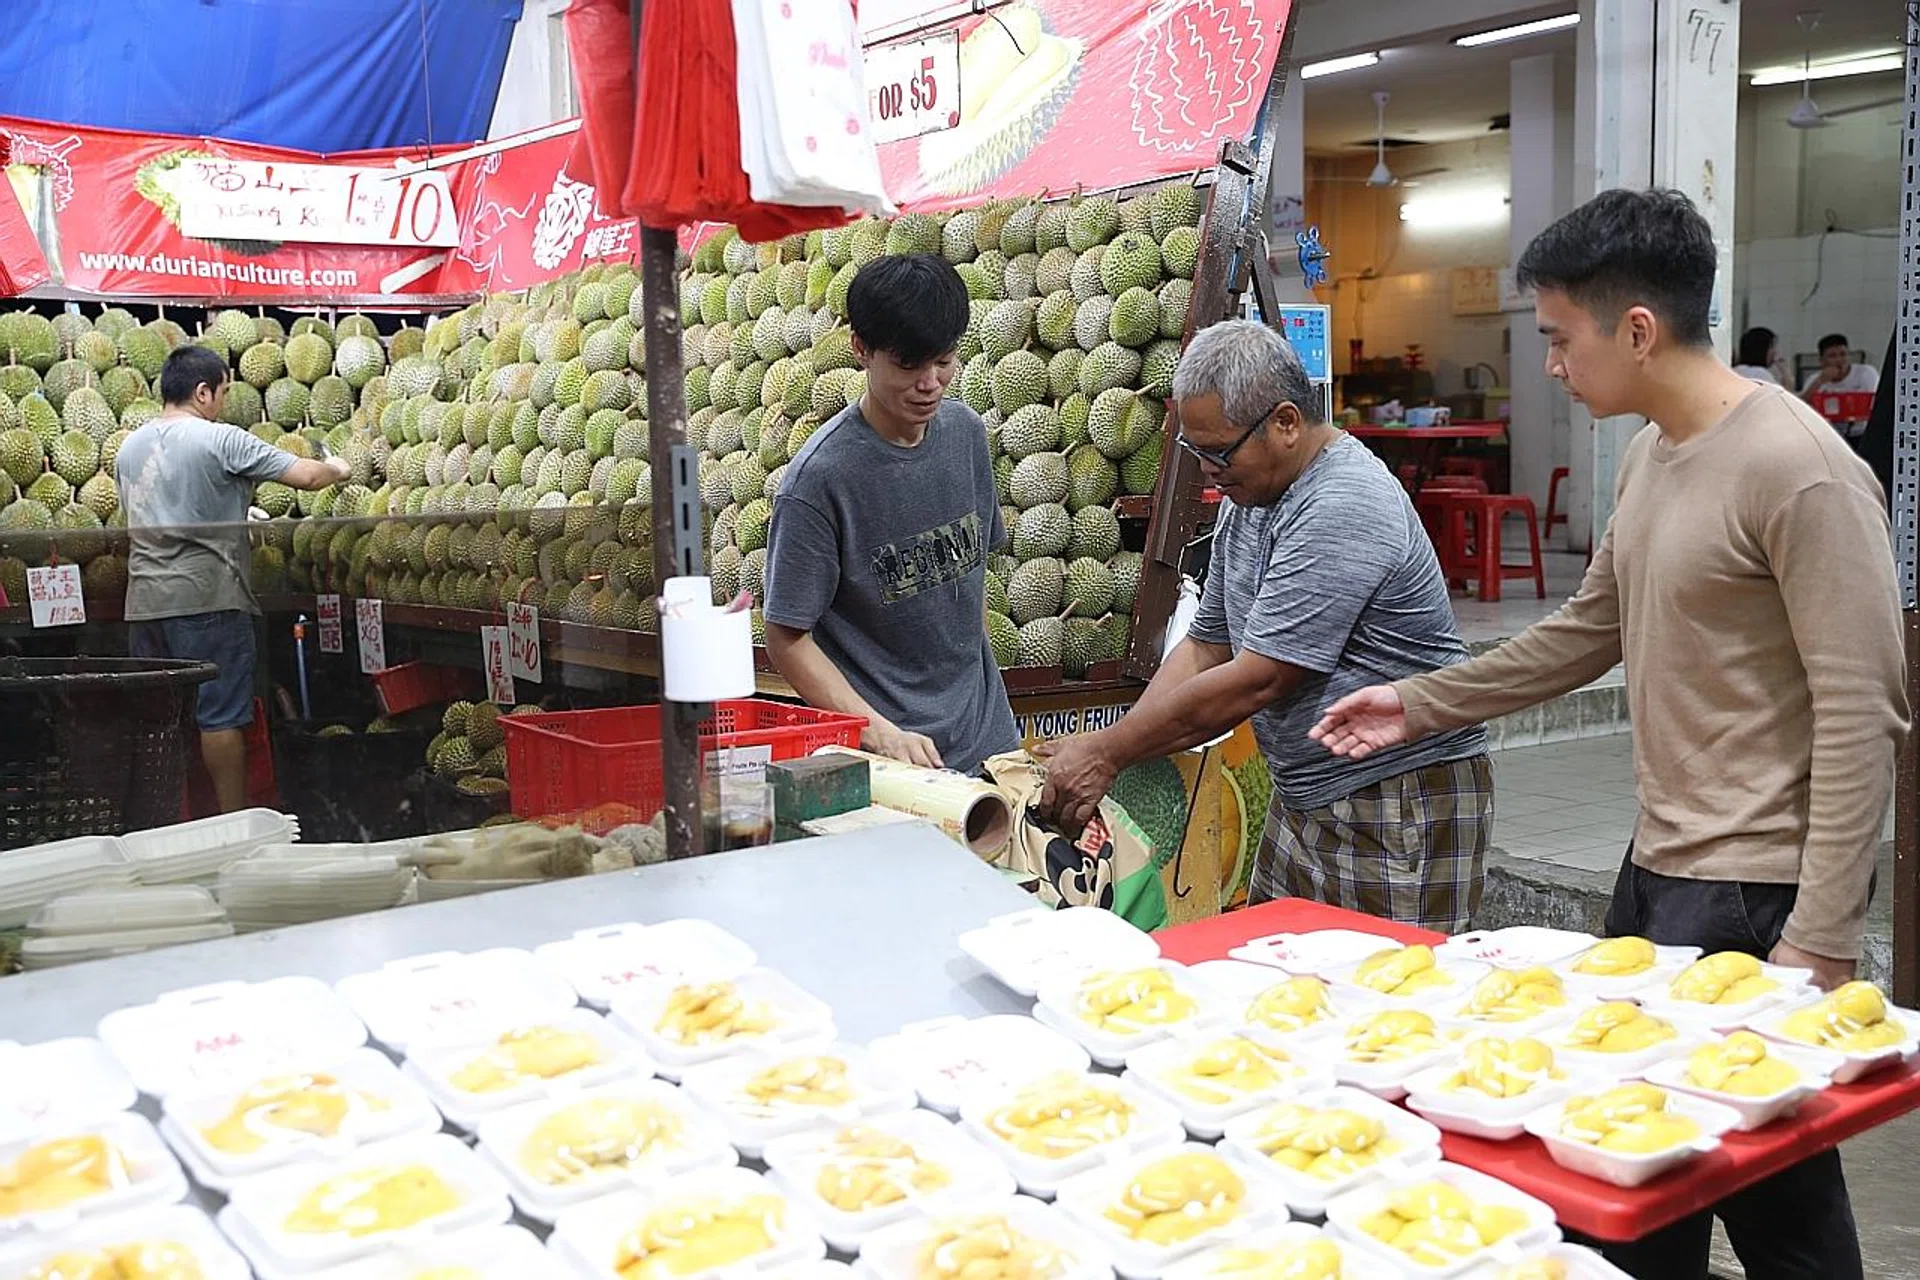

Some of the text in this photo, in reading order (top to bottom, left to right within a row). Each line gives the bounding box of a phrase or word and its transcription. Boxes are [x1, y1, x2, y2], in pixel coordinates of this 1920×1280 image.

[1687, 8, 1726, 76] 77
[910, 55, 938, 119] $5
[79, 251, 358, 287] www.durianculture.com
[1032, 708, 1079, 738] YONG
